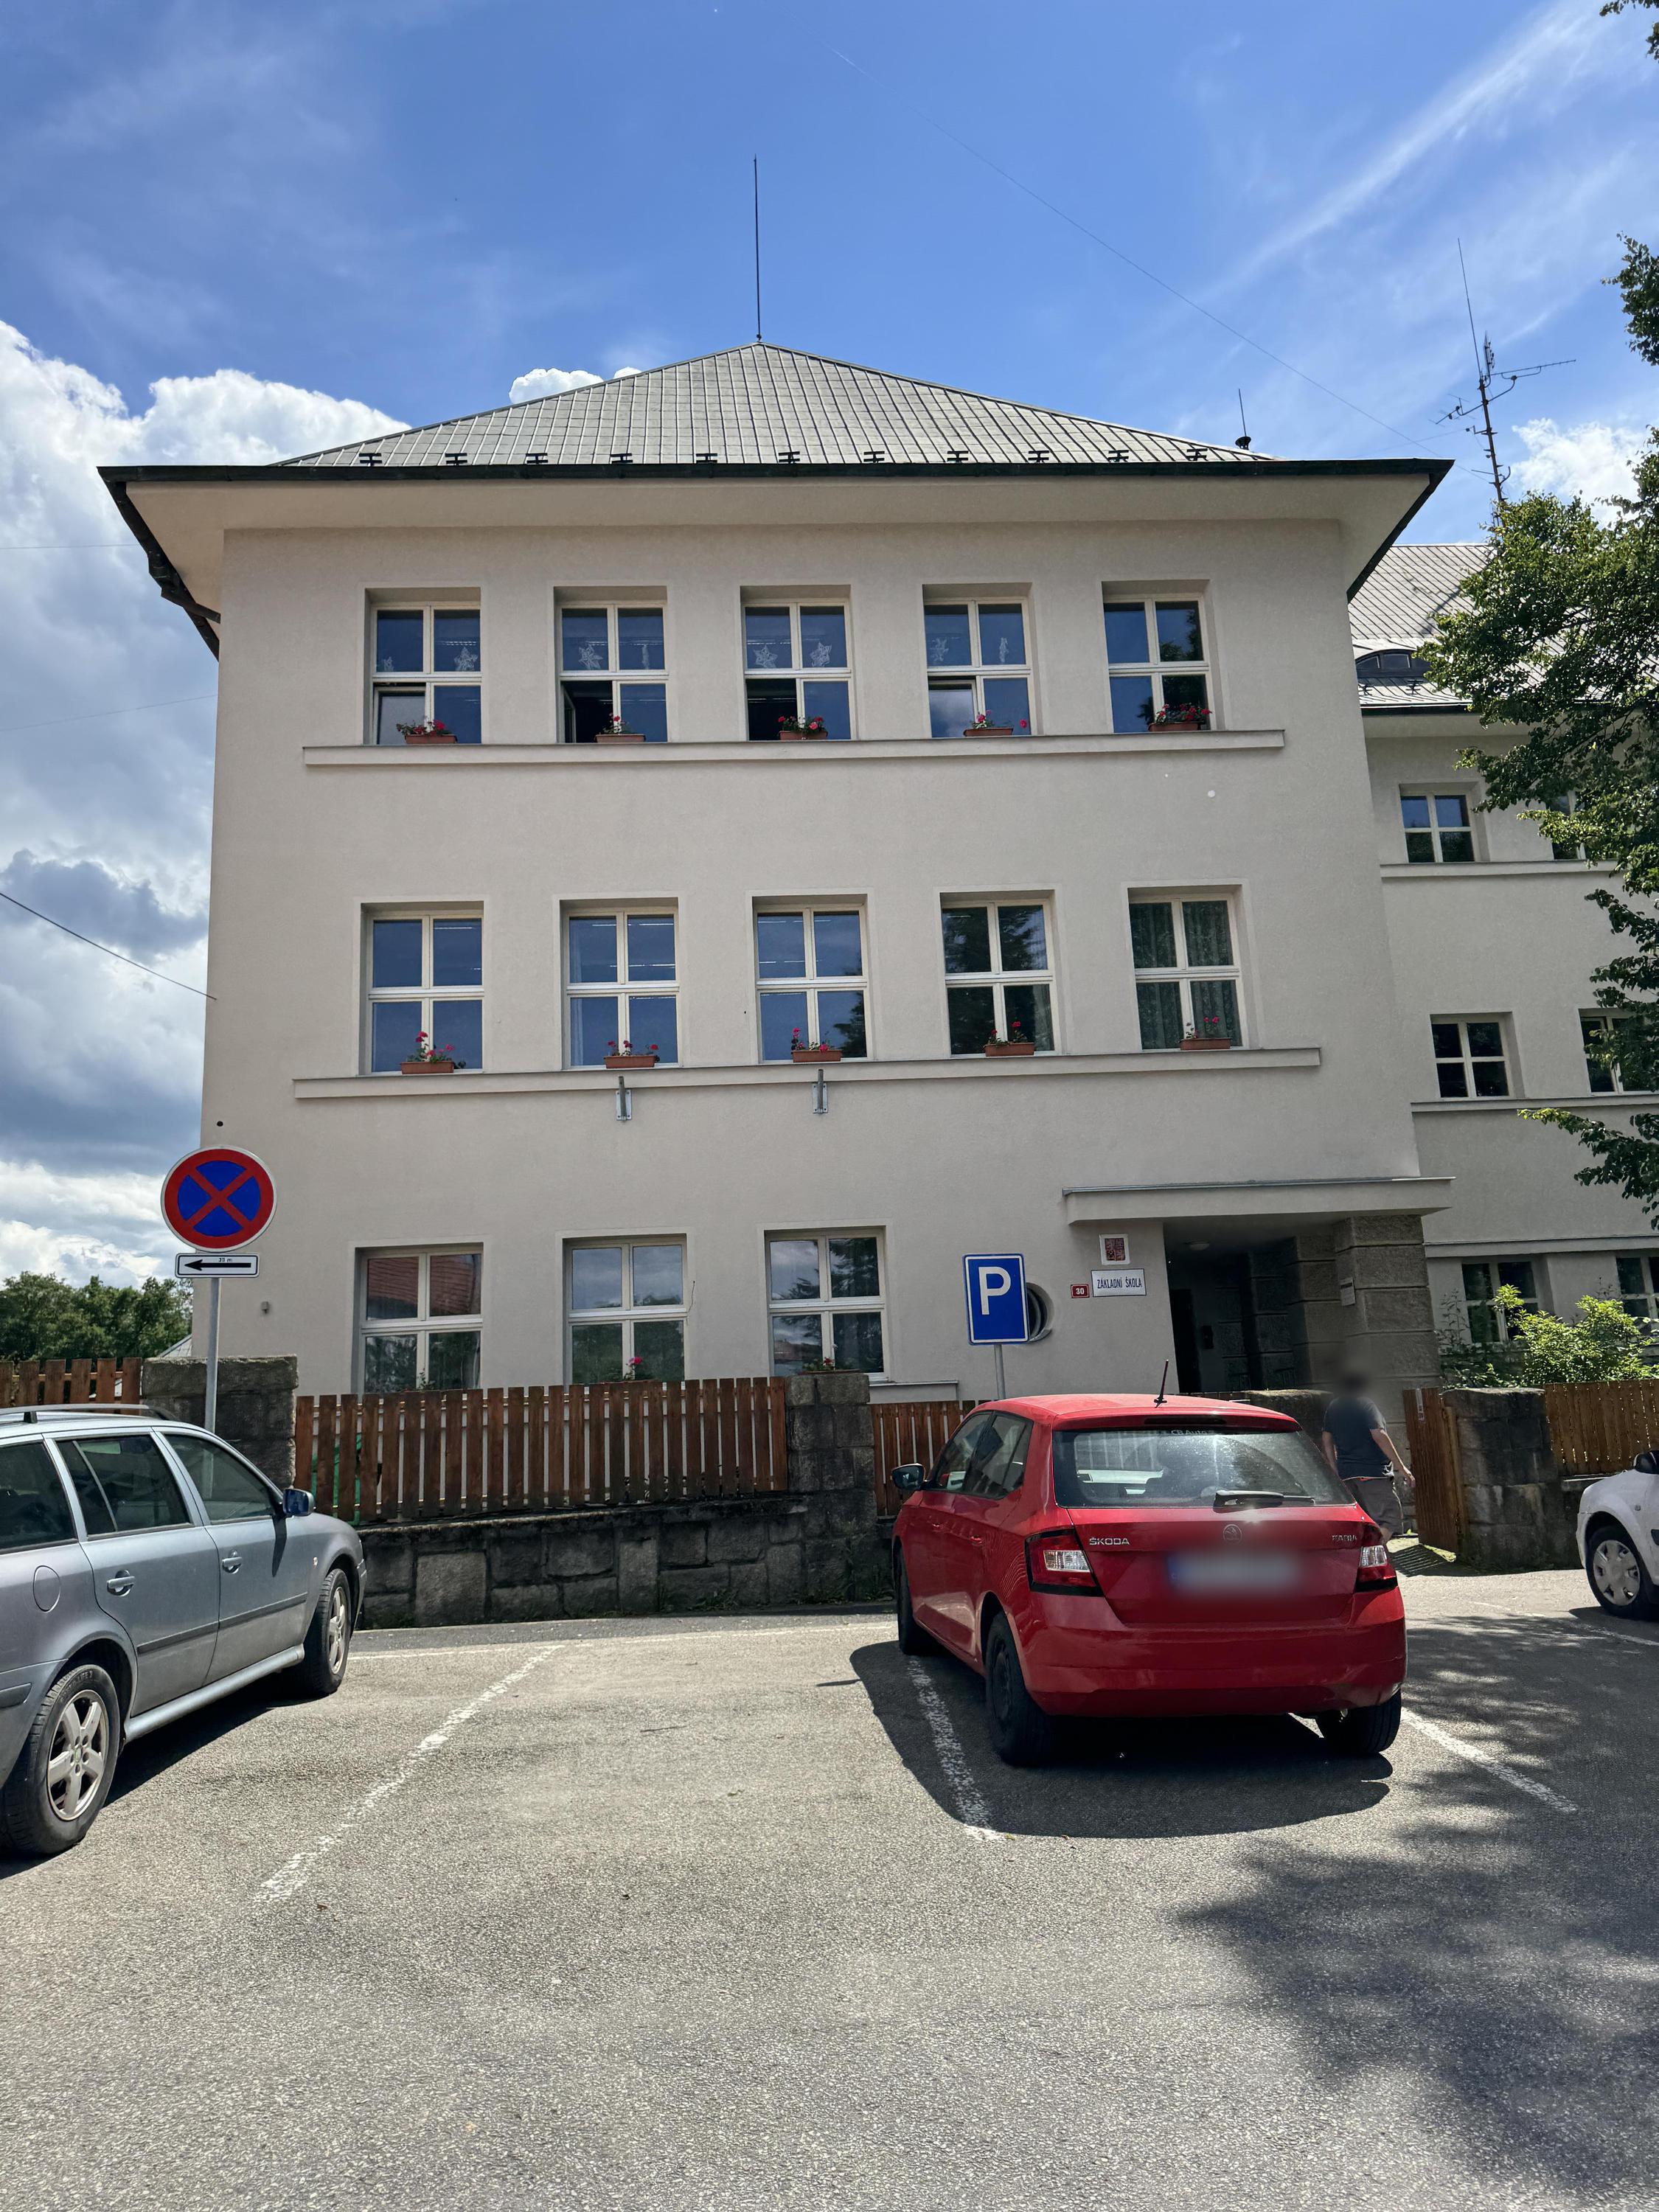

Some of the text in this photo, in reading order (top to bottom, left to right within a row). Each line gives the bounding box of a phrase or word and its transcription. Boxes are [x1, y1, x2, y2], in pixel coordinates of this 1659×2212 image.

[1096, 1276, 1142, 1289] ZÁKLADNÍ ŠKOLA
[978, 1266, 1012, 1315] P
[1089, 1537, 1130, 1545] ŠKODA
